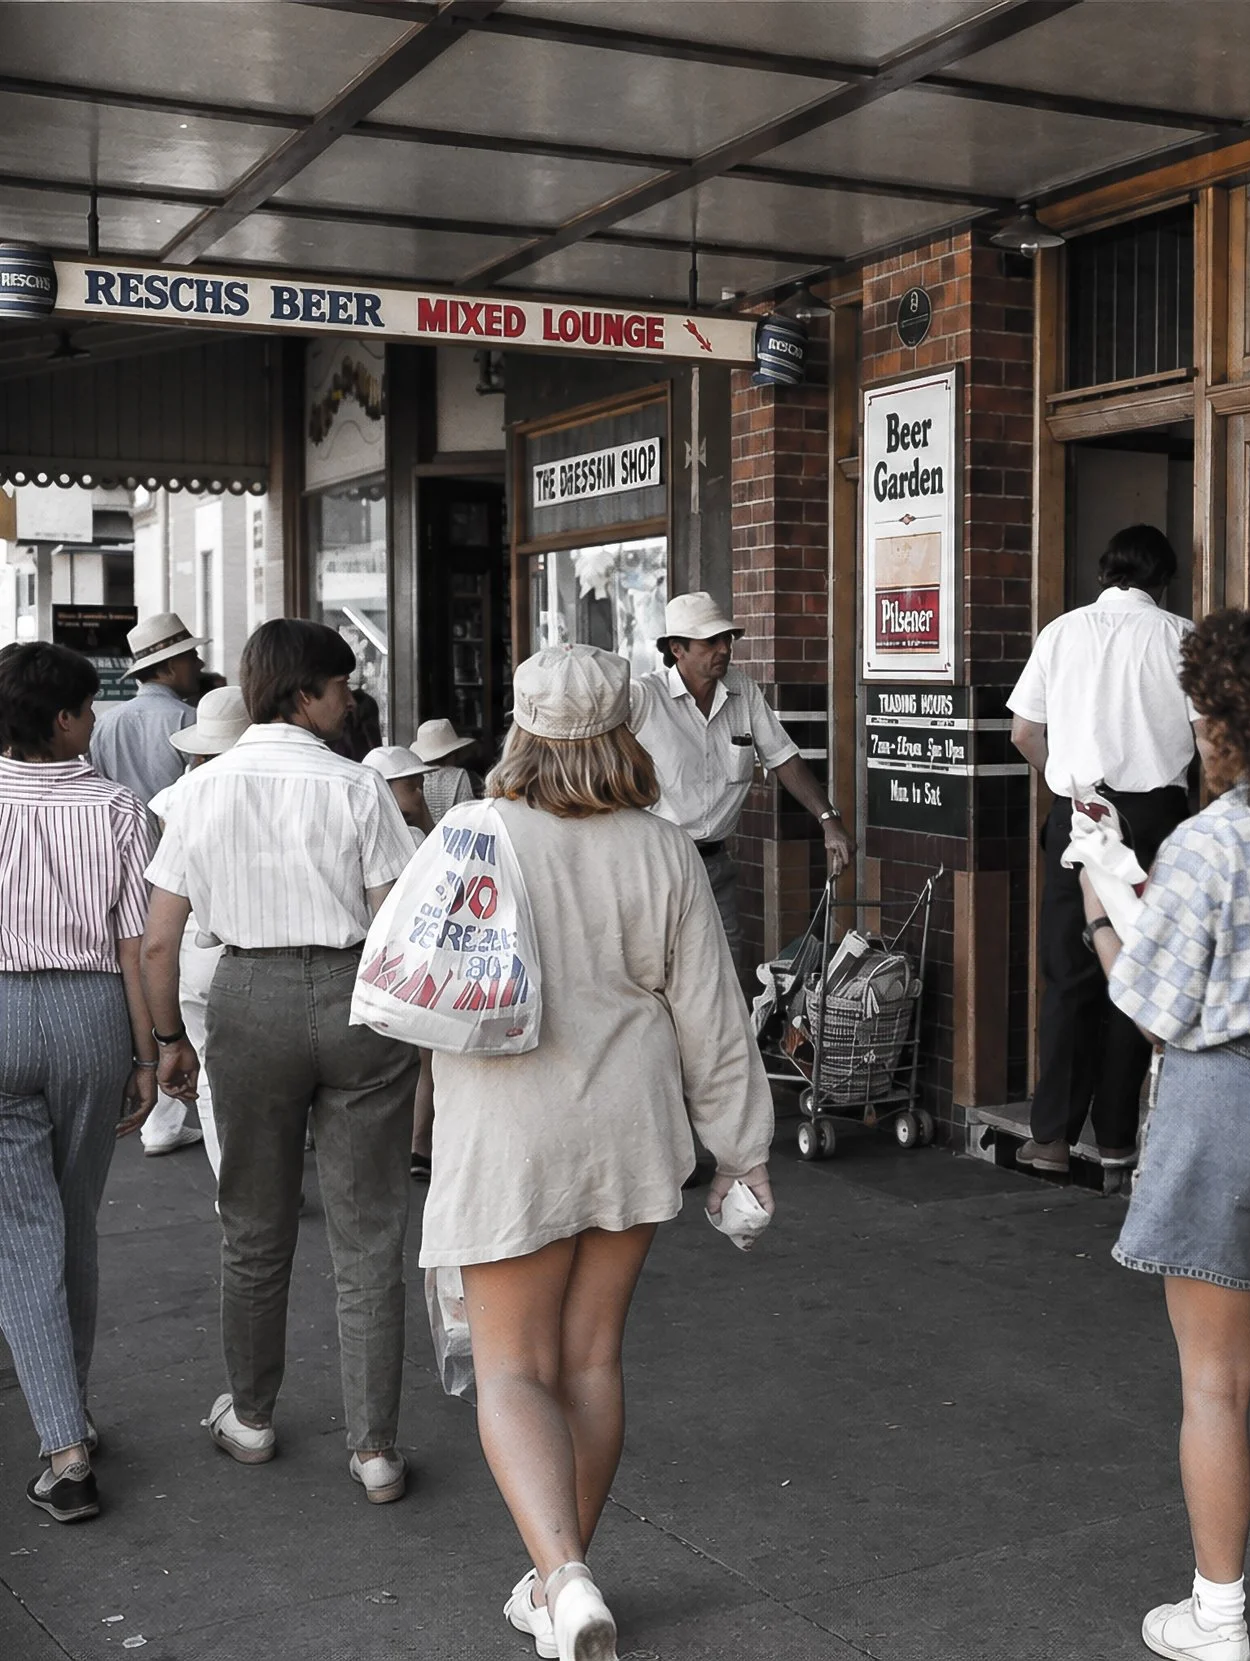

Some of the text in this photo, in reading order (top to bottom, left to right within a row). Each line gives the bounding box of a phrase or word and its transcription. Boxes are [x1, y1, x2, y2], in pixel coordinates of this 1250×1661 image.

[85, 270, 665, 350] RESCHS BEER MIXED LOUNGE
[886, 412, 932, 453] Beer
[621, 444, 656, 485] SHOP
[874, 457, 944, 502] Garden
[881, 600, 934, 634] Pilsener
[878, 693, 953, 716] TRADING HOURS
[925, 782, 942, 807] Sat
